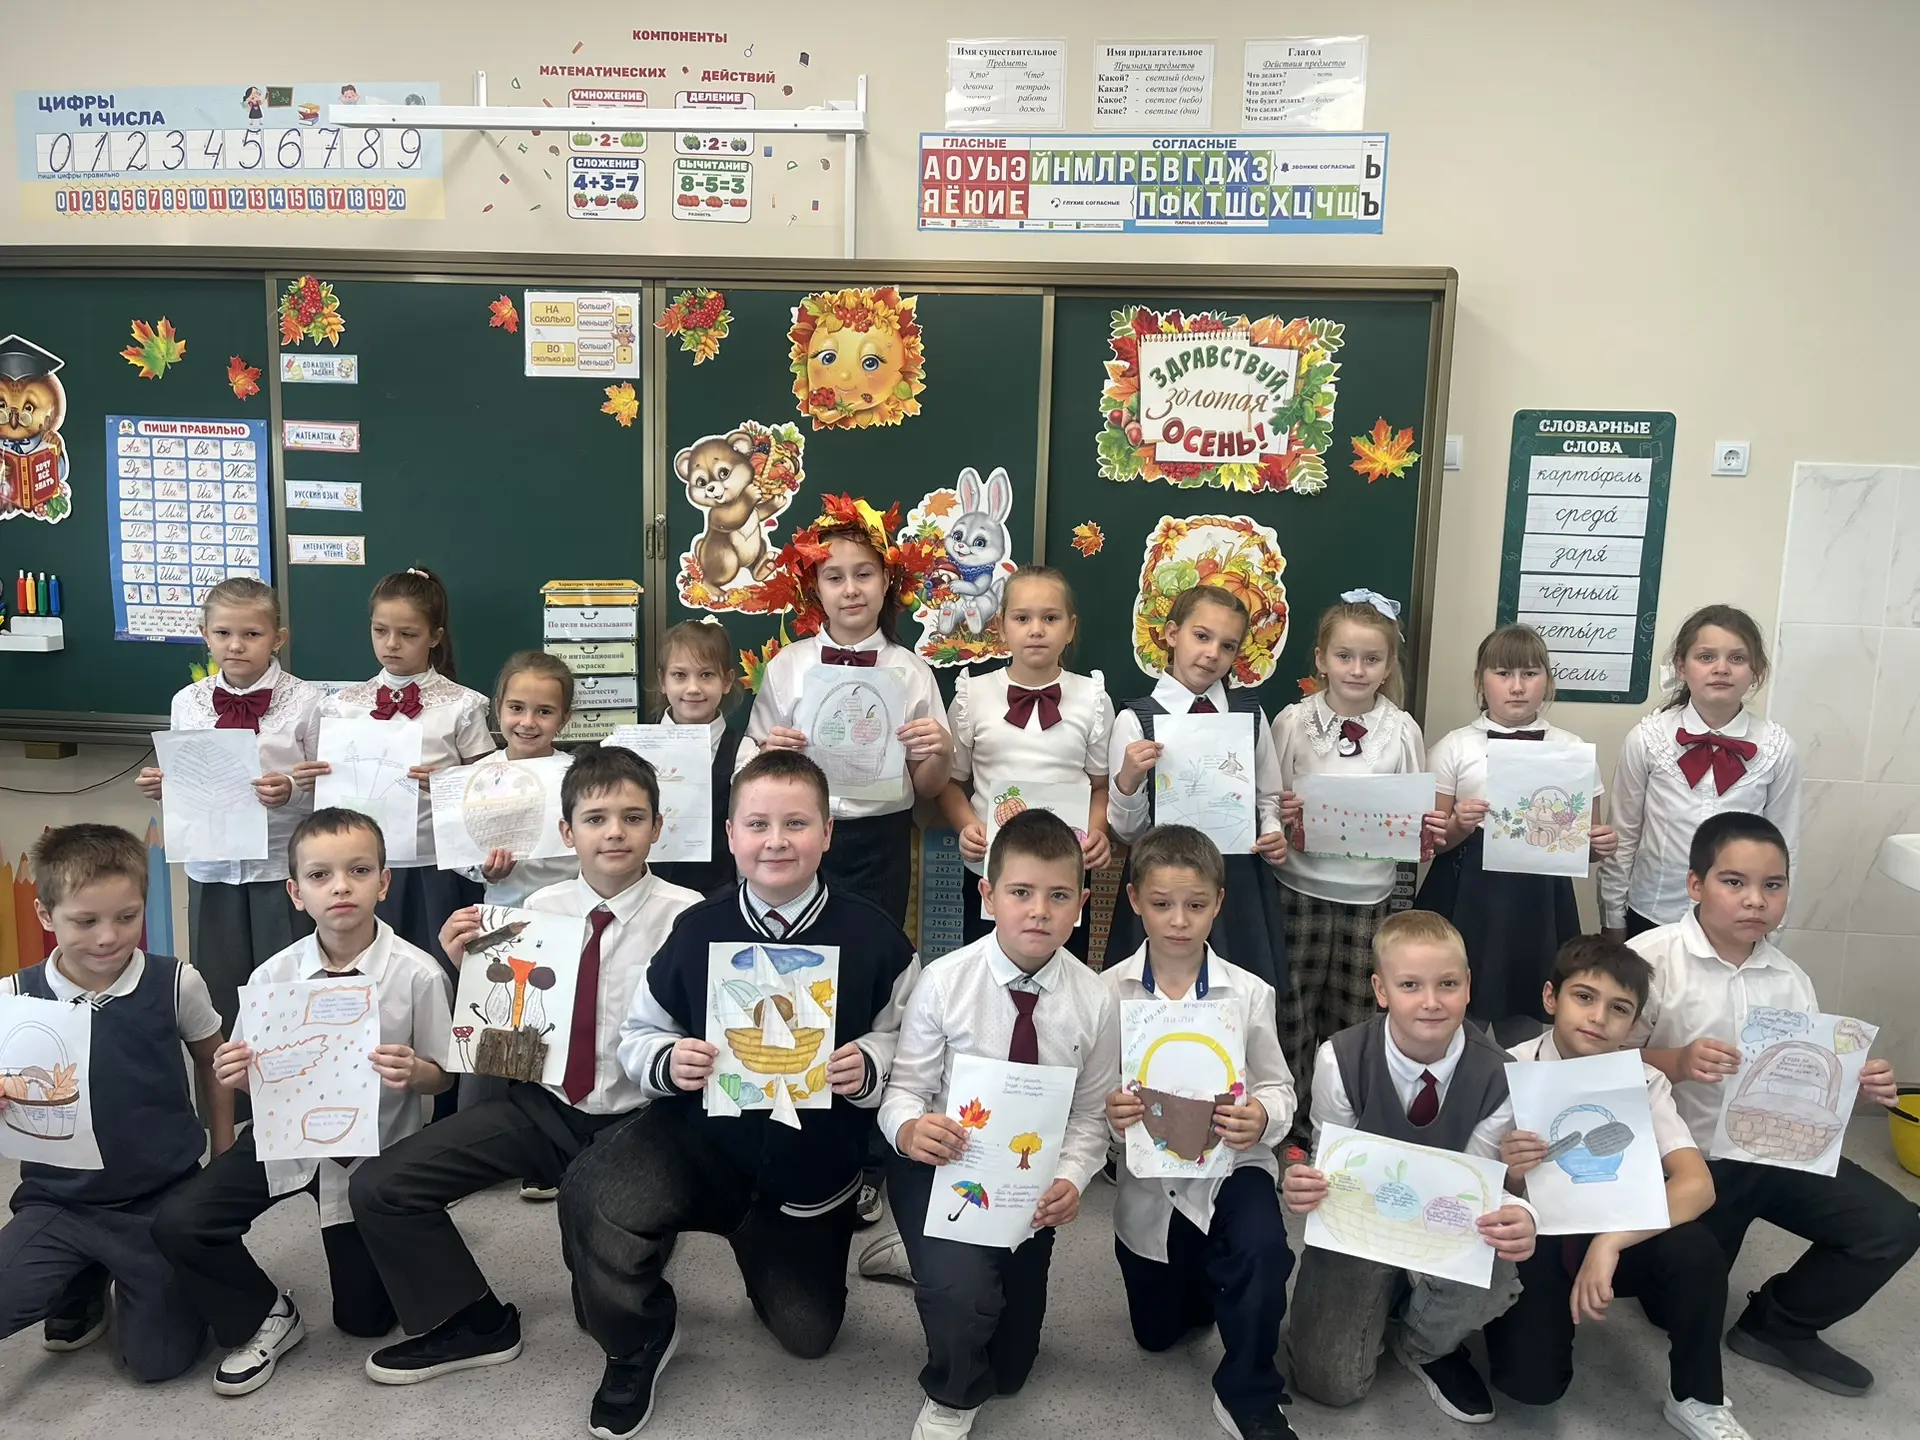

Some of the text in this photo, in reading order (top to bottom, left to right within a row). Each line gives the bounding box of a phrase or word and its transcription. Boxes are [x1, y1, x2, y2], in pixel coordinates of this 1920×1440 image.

[632, 29, 728, 44] КОМПОНЕНТЫ
[957, 47, 1058, 58] Имя существительное
[1106, 48, 1203, 58] Имя прилагательное
[1288, 48, 1321, 56] Глагол
[986, 59, 1028, 68] Предметы
[1113, 61, 1195, 71] Признаки предметов
[1263, 59, 1346, 69] Действия предметов
[539, 65, 776, 84] МАТЕМАТИЧЕСКИХ ДЕЙСТВИЙ
[969, 70, 989, 79] Кто?
[1024, 70, 1045, 79] Что?
[1098, 73, 1205, 82] Какой? светлый (день)
[963, 83, 994, 91] девочка
[1015, 83, 1051, 92] тетрадь
[1098, 85, 1129, 93] Какая?
[1179, 85, 1203, 93] (ночь)
[573, 90, 643, 101] УМНОЖЕНИЕ
[689, 93, 741, 103] ДЕЛЕНИЕ
[1017, 94, 1048, 103] работа
[1097, 96, 1127, 104] Какое?
[1178, 95, 1203, 104] (небо)
[38, 95, 115, 113] ЦИФРЫ
[1018, 104, 1046, 113] дождь
[963, 105, 991, 114] сорока
[1097, 107, 1127, 115] Какие?
[1180, 107, 1200, 115] (дни)
[79, 110, 166, 127] И ЧИСЛА
[942, 138, 1007, 149] ГЛАСНЫЕ
[1152, 139, 1237, 150] СОГЛАСНЫЕ
[49, 128, 421, 172] 0 1 2 3 4 5 6 7 8 9
[575, 158, 637, 169] СЛОЖЕНИЕ
[680, 160, 747, 171] ВЫЧИТАНИЕ
[57, 190, 405, 209] 0 1 2 3 4 5 6 7 8 9 10 11 12 13 14 15 16 17 18 19 20
[545, 305, 559, 314] НА
[579, 302, 611, 311] больше?
[579, 319, 613, 327] меньше?
[547, 344, 560, 353] ВО
[580, 342, 612, 351] больше?
[302, 361, 334, 369] ДОМАШНЕЕ
[580, 358, 614, 367] меньше?
[311, 368, 335, 376] ЗАДАНИЕ
[1149, 345, 1290, 401] ЗДРАВСТВУЙ,
[1145, 387, 1270, 420] золотая
[144, 423, 245, 435] ПИШИ ПРАВИЛЬНО
[1538, 419, 1651, 435] СЛОВАРНЫЕ
[295, 431, 336, 441] МАТЕМАТИКА
[1162, 416, 1269, 457] ОСЕНЬ!
[1562, 439, 1623, 454] СЛОВА
[35, 459, 51, 472] ХОЧУ
[35, 477, 55, 491] ЗНАТЬ
[294, 490, 340, 500] РУССКИЙ ЯЗЫК
[302, 542, 344, 550] ЛИТЕРАТУРНОЕ
[323, 550, 344, 558] ЧТЕНИЕ
[1538, 582, 1619, 607] чёрный
